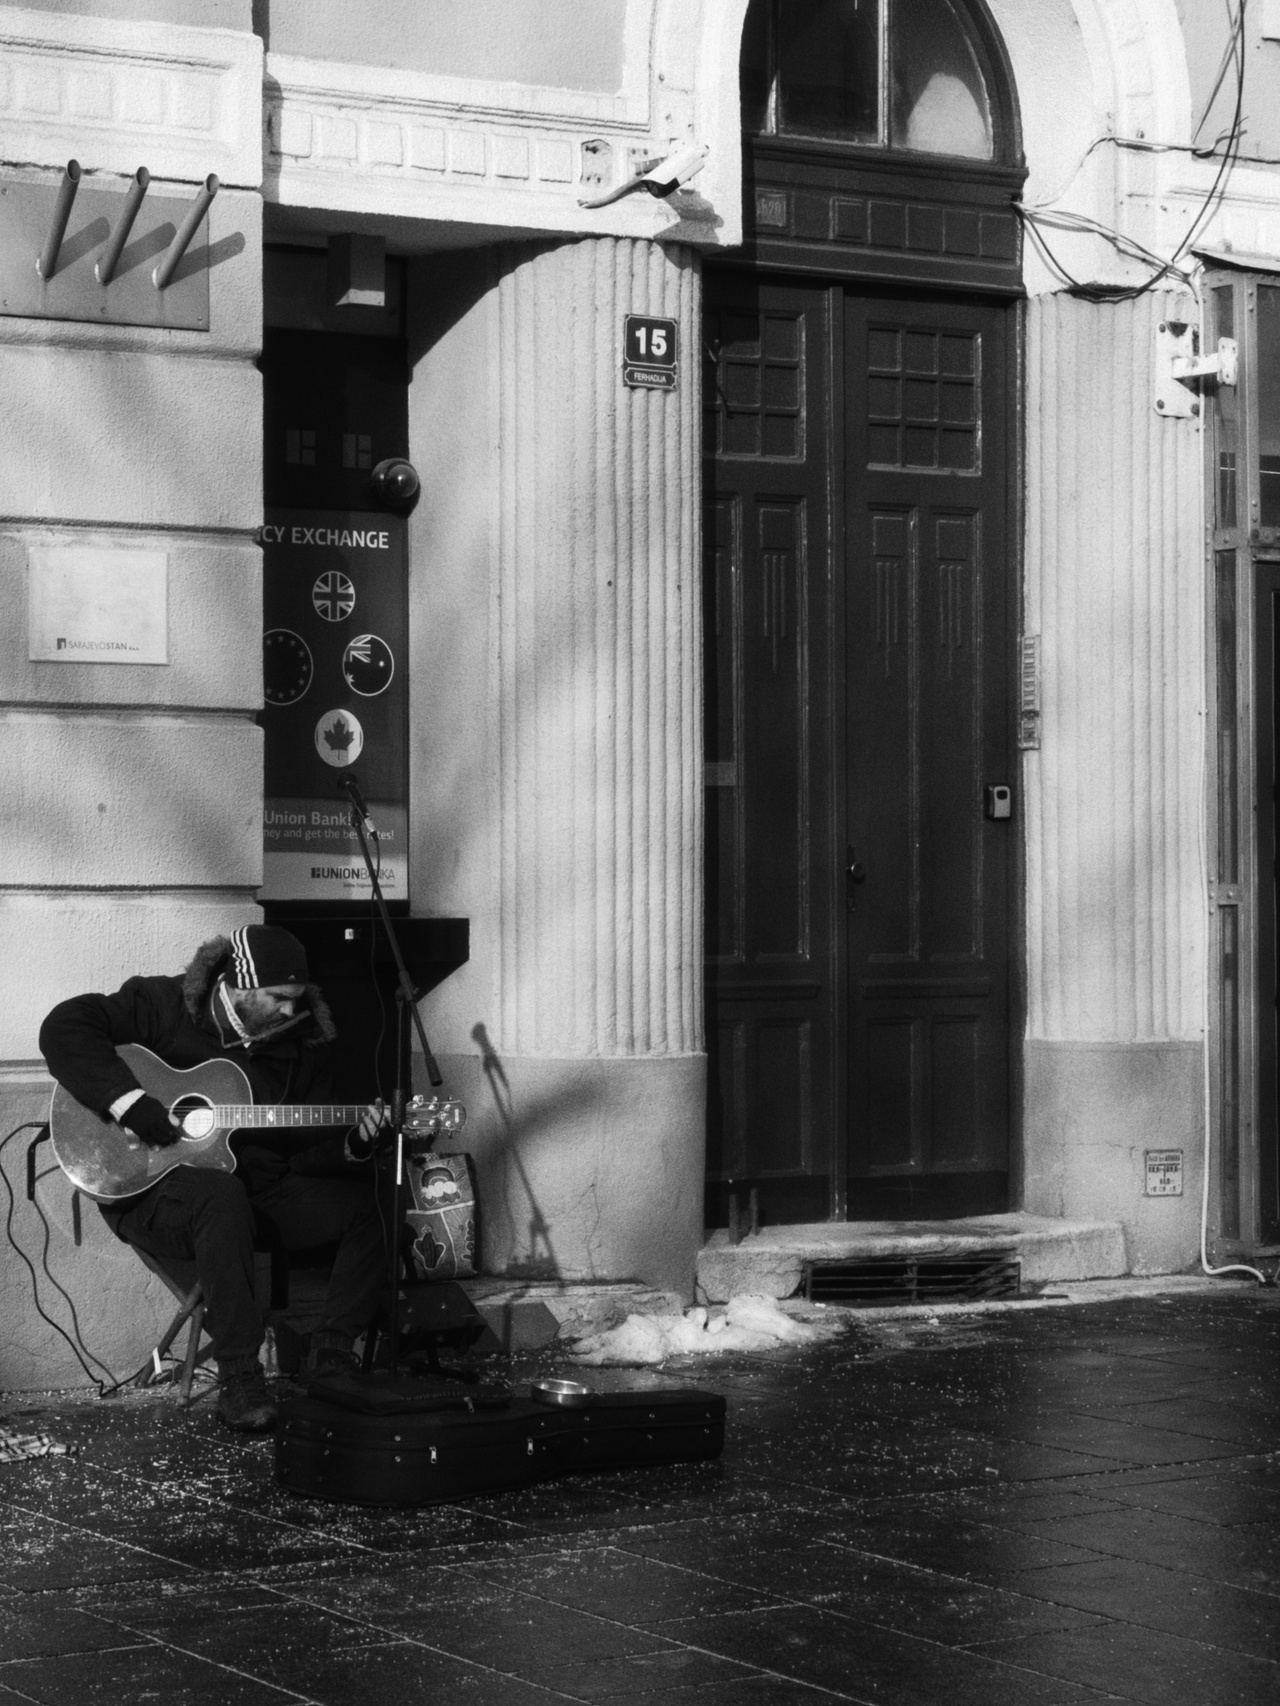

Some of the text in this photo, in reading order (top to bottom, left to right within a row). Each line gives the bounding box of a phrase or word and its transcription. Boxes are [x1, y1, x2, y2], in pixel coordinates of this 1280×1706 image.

[635, 327, 667, 356] 15
[634, 372, 667, 383] FERHADIJA
[292, 527, 390, 549] EXCHANGE
[68, 640, 127, 650] SARAJEVOSTAN
[264, 810, 352, 826] Union Bank!
[284, 828, 302, 838] and
[305, 829, 321, 841] get
[324, 829, 340, 839] the
[343, 829, 363, 840] bes
[366, 830, 394, 840] rtes!
[322, 868, 395, 880] UNIONBNKA
